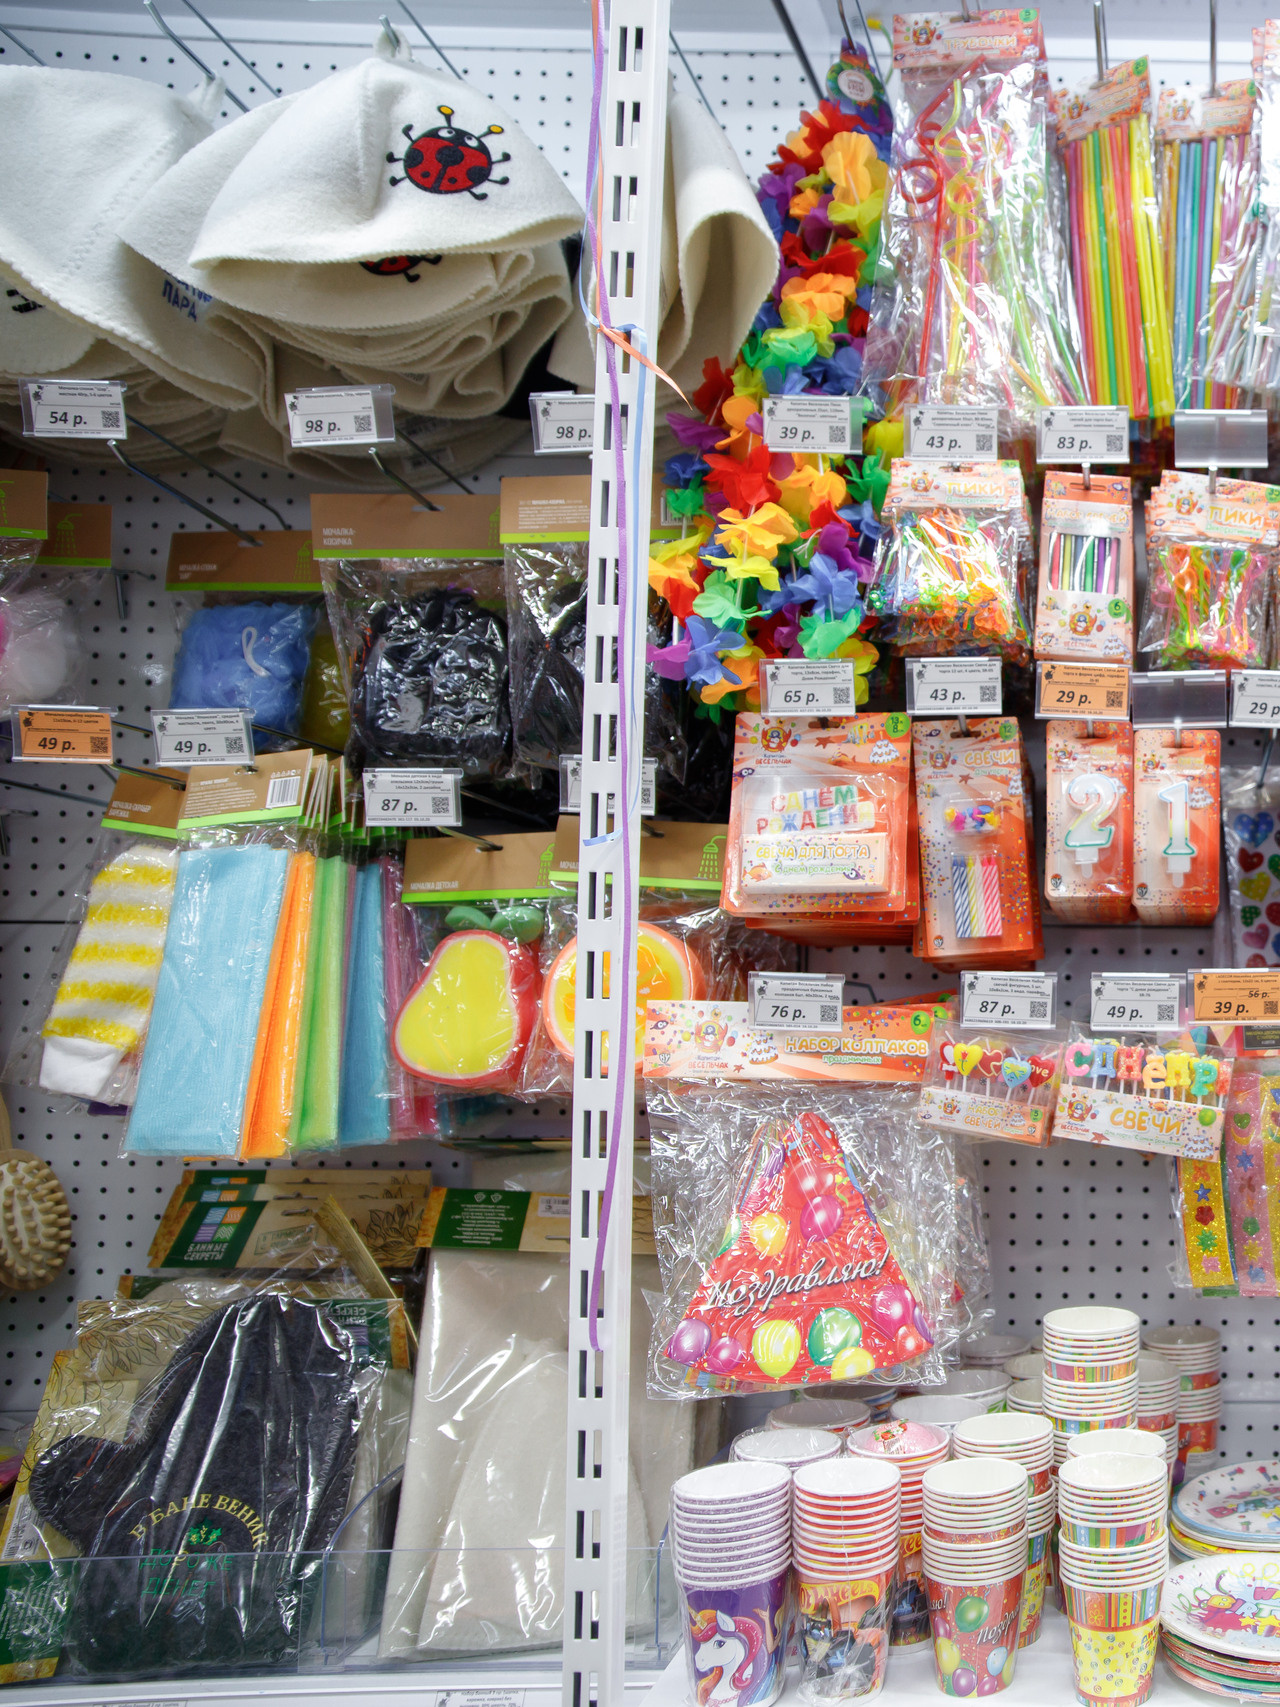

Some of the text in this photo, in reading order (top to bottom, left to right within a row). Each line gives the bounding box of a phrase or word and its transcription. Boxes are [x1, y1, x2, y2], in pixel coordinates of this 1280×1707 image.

[49, 411, 87, 428] 54 р.
[305, 419, 341, 435] 98 р.
[556, 425, 592, 441] 98 р.
[779, 426, 815, 443] 39 р.
[925, 435, 962, 452] 43 р.
[1056, 436, 1092, 453] 83 р.
[946, 482, 1004, 497] ПИКИ
[1209, 505, 1264, 528] ПИКИ
[783, 690, 819, 706] 65 р.
[929, 688, 966, 704] 43 р.
[1055, 690, 1092, 707] 29 р.
[1249, 701, 1268, 715] 29
[37, 737, 76, 753] 49 р.
[173, 740, 212, 756] 49 р.
[965, 750, 1016, 766] СВЕЧИ
[381, 798, 418, 815] 87 р.
[1065, 773, 1118, 849] 2
[1158, 780, 1198, 857] 1
[798, 846, 825, 860] ДЛЯ
[827, 845, 869, 859] ТОРТА
[771, 1005, 806, 1022] 76 р.
[979, 1000, 1015, 1017] 87 р.
[1106, 1005, 1143, 1022] 49 р.
[1213, 1001, 1249, 1017] 39 р.
[785, 1037, 928, 1056] НАБОР КОЛПАКОВ
[688, 1061, 730, 1069] ВЕСЕЛЬЧАК
[822, 1054, 882, 1065] праздничных
[1109, 1106, 1183, 1137] СВЕЧИ
[183, 1251, 225, 1261] СЕКРЕТЫ
[187, 1243, 229, 1252] БАННЫЕ
[707, 1248, 891, 1317] Поздравляю!
[148, 1493, 212, 1526] БАНЕ
[212, 1494, 268, 1549] ВЕНИК
[139, 1548, 235, 1571] ДОРОЖЕ
[140, 1577, 216, 1600] ДЕНЕГ
